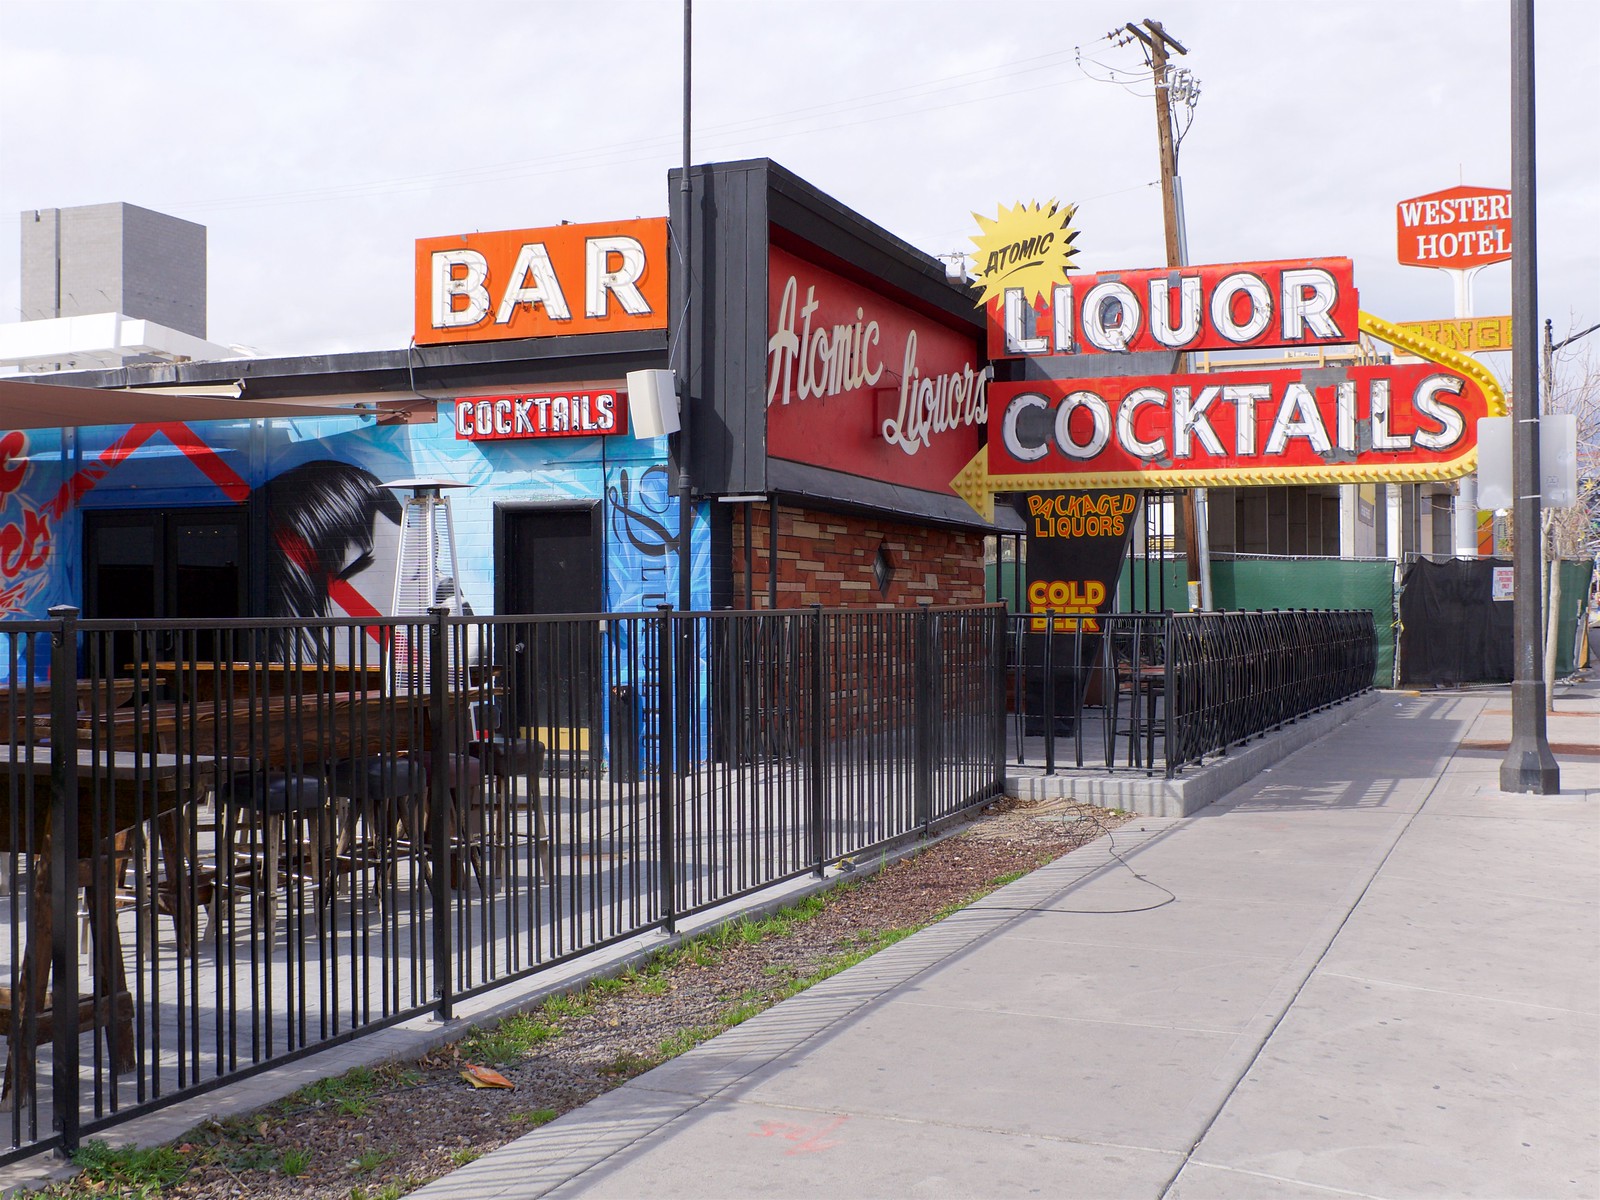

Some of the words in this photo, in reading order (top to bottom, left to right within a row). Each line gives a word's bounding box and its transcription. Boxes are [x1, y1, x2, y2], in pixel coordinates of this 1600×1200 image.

[1399, 193, 1512, 228] WESTER
[983, 231, 1054, 278] ATOMIC
[1416, 228, 1512, 260] HOTEL
[431, 235, 654, 330] BAR
[1004, 267, 1344, 355] LIQUOR
[768, 275, 884, 408] Atomic
[1400, 319, 1512, 350] ING
[882, 329, 988, 456] Liquors
[456, 393, 615, 436] COCKTAILS
[1002, 372, 1467, 462] COCKTAILS
[1027, 493, 1136, 520] PACKAGED
[1035, 515, 1125, 539] LIQUORS
[1028, 579, 1106, 606] COLD
